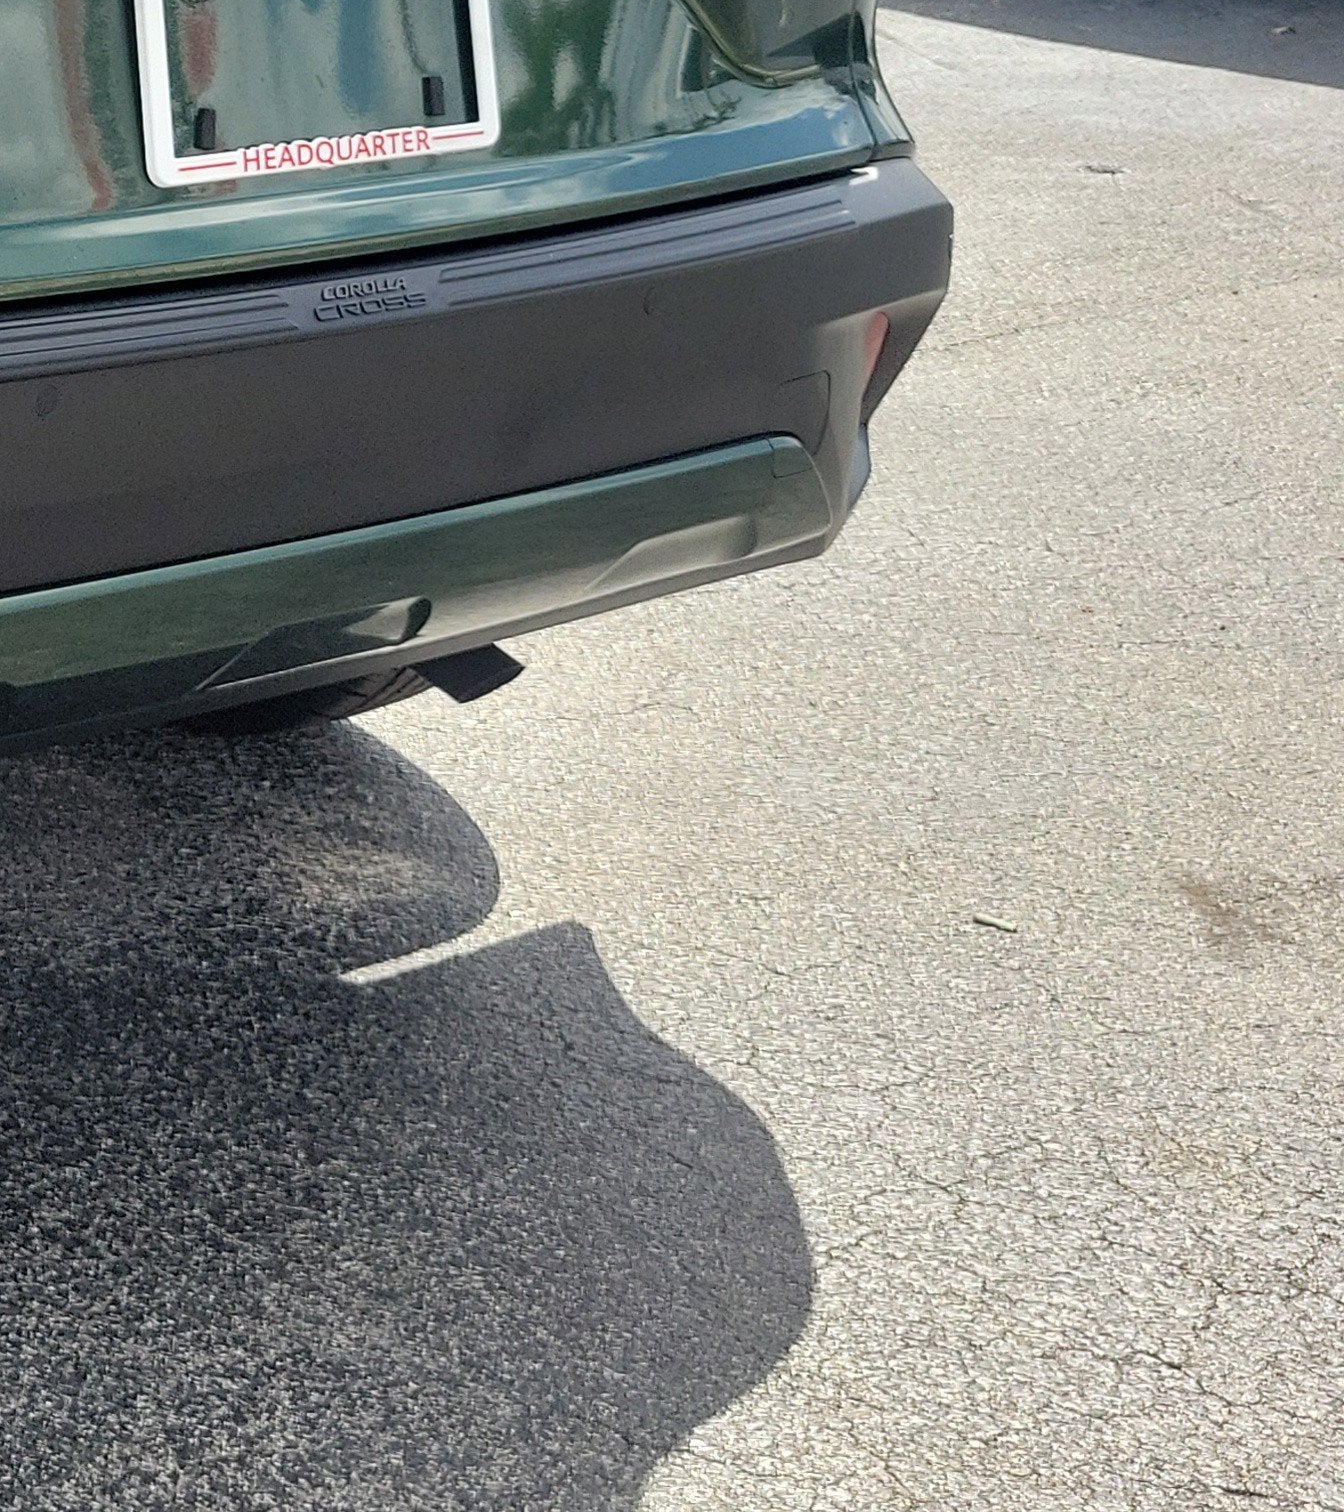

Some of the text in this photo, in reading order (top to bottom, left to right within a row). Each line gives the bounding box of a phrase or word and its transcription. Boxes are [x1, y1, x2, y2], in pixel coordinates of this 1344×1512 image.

[242, 129, 431, 172] HEADQUARTER
[321, 276, 406, 302] COROLLA
[313, 291, 427, 322] CROSS
